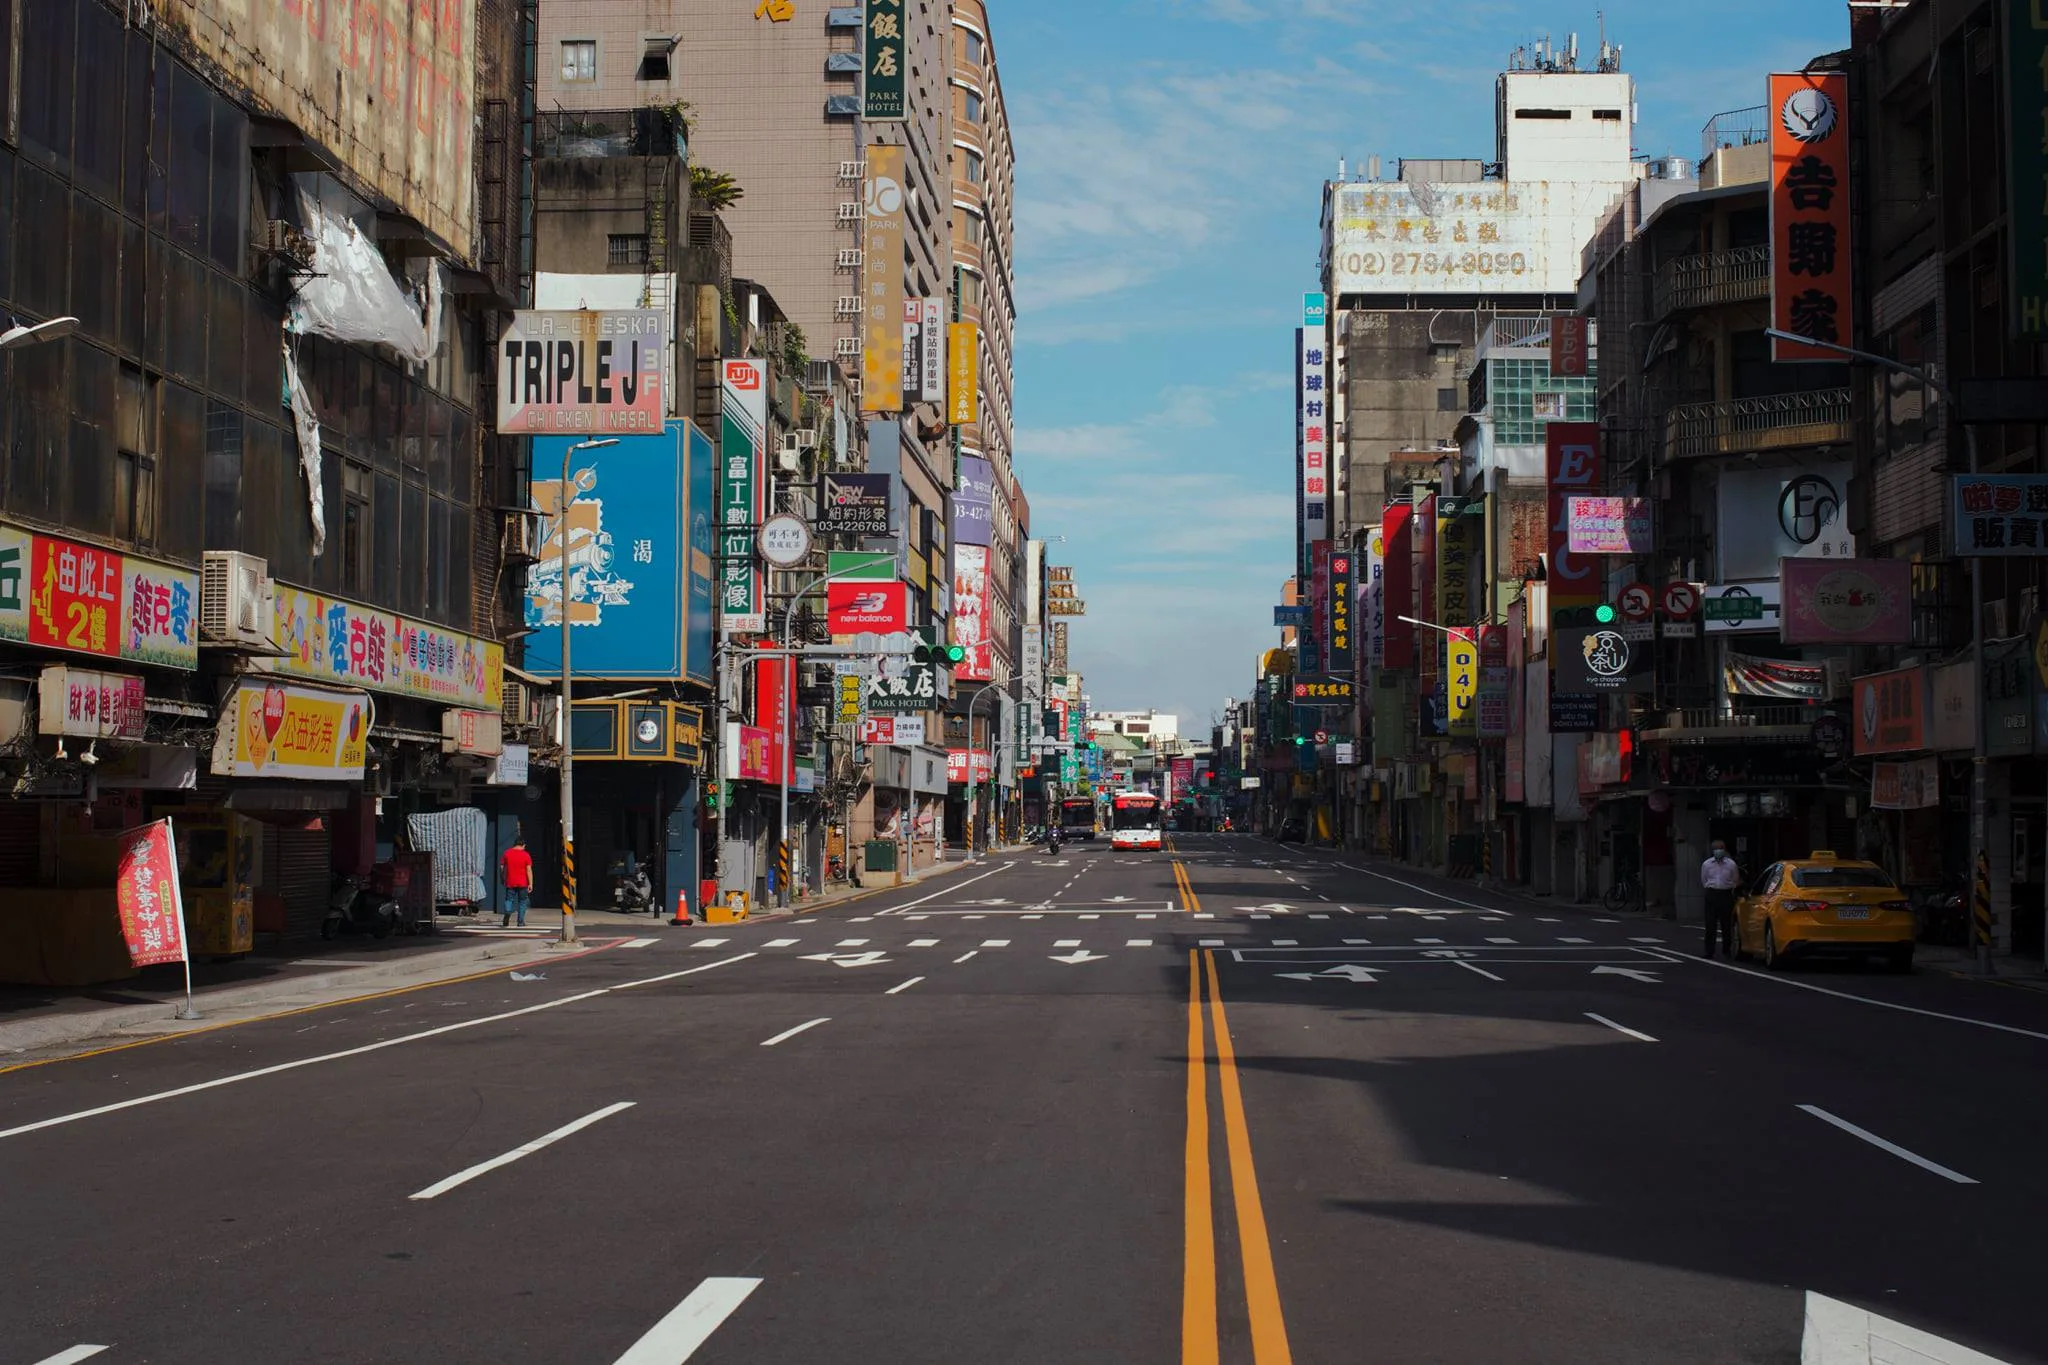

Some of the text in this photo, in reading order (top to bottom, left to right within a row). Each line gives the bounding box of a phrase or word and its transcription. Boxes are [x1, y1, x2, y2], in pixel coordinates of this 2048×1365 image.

[870, 0, 901, 77] 飯店
[867, 103, 901, 111] HOTEL
[870, 92, 898, 100] PARK
[871, 221, 899, 230] PARK
[1786, 156, 1838, 344] 吉野家
[526, 316, 659, 336] LA-CHESKA
[1559, 317, 1578, 374] EEC
[506, 340, 638, 405] TRIPLE J
[527, 410, 657, 428] CHICKEN INASAL
[1306, 349, 1324, 520] 地球村美日韓語
[819, 521, 887, 531] 03-4226768
[829, 507, 886, 520] 紐約形象
[725, 456, 749, 609] 富士數位影像
[1973, 517, 2048, 549] 販賣
[634, 540, 652, 564] 渴
[59, 546, 116, 602] 由此上
[66, 602, 106, 652] 2樓
[859, 614, 892, 623] balance
[328, 604, 386, 684] 麥克熊
[867, 669, 935, 698] 大飯店
[872, 699, 928, 708] PARK HOTEL
[283, 711, 333, 753] 公益彩券
